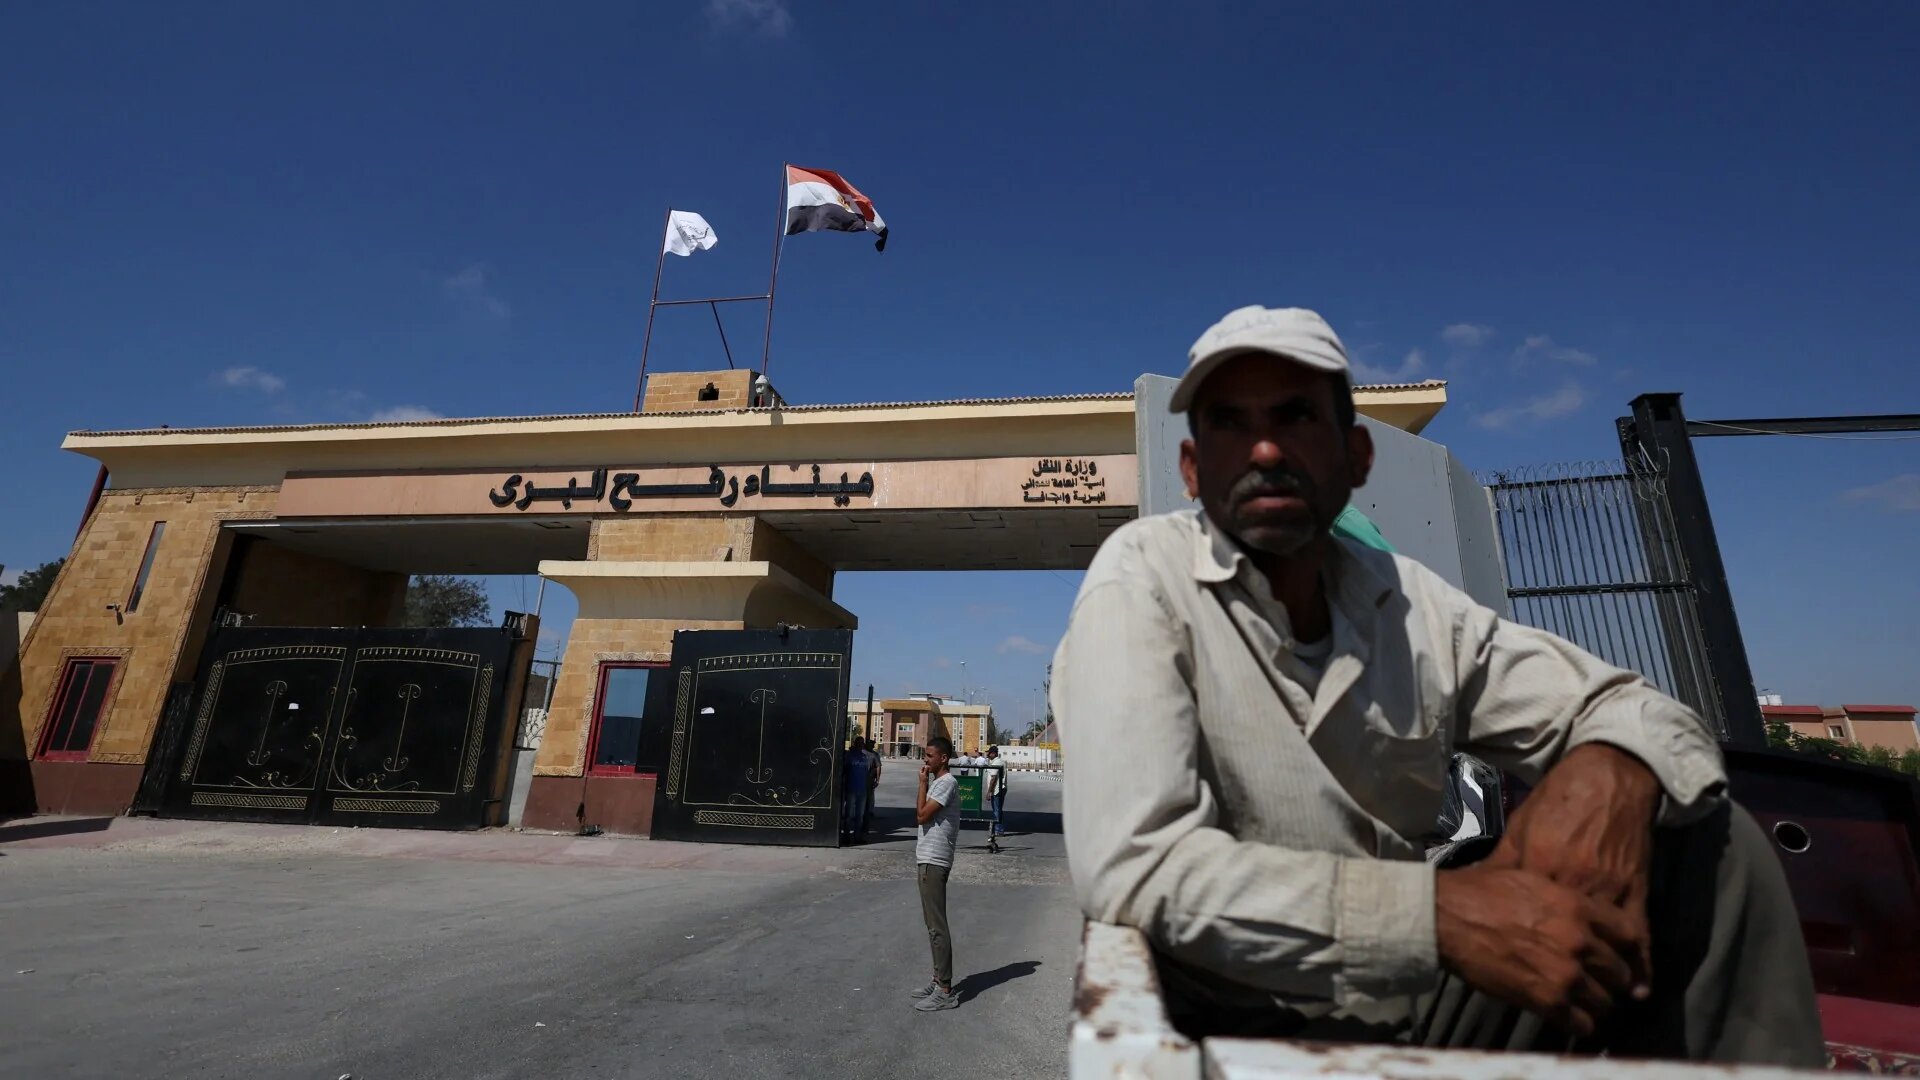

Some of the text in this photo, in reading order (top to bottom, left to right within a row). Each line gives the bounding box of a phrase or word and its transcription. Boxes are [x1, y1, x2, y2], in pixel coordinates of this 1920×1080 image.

[1032, 458, 1097, 477] وزارة النقل
[1051, 477, 1077, 488] العامة
[610, 463, 739, 512] رفح
[742, 463, 873, 507] ميناء
